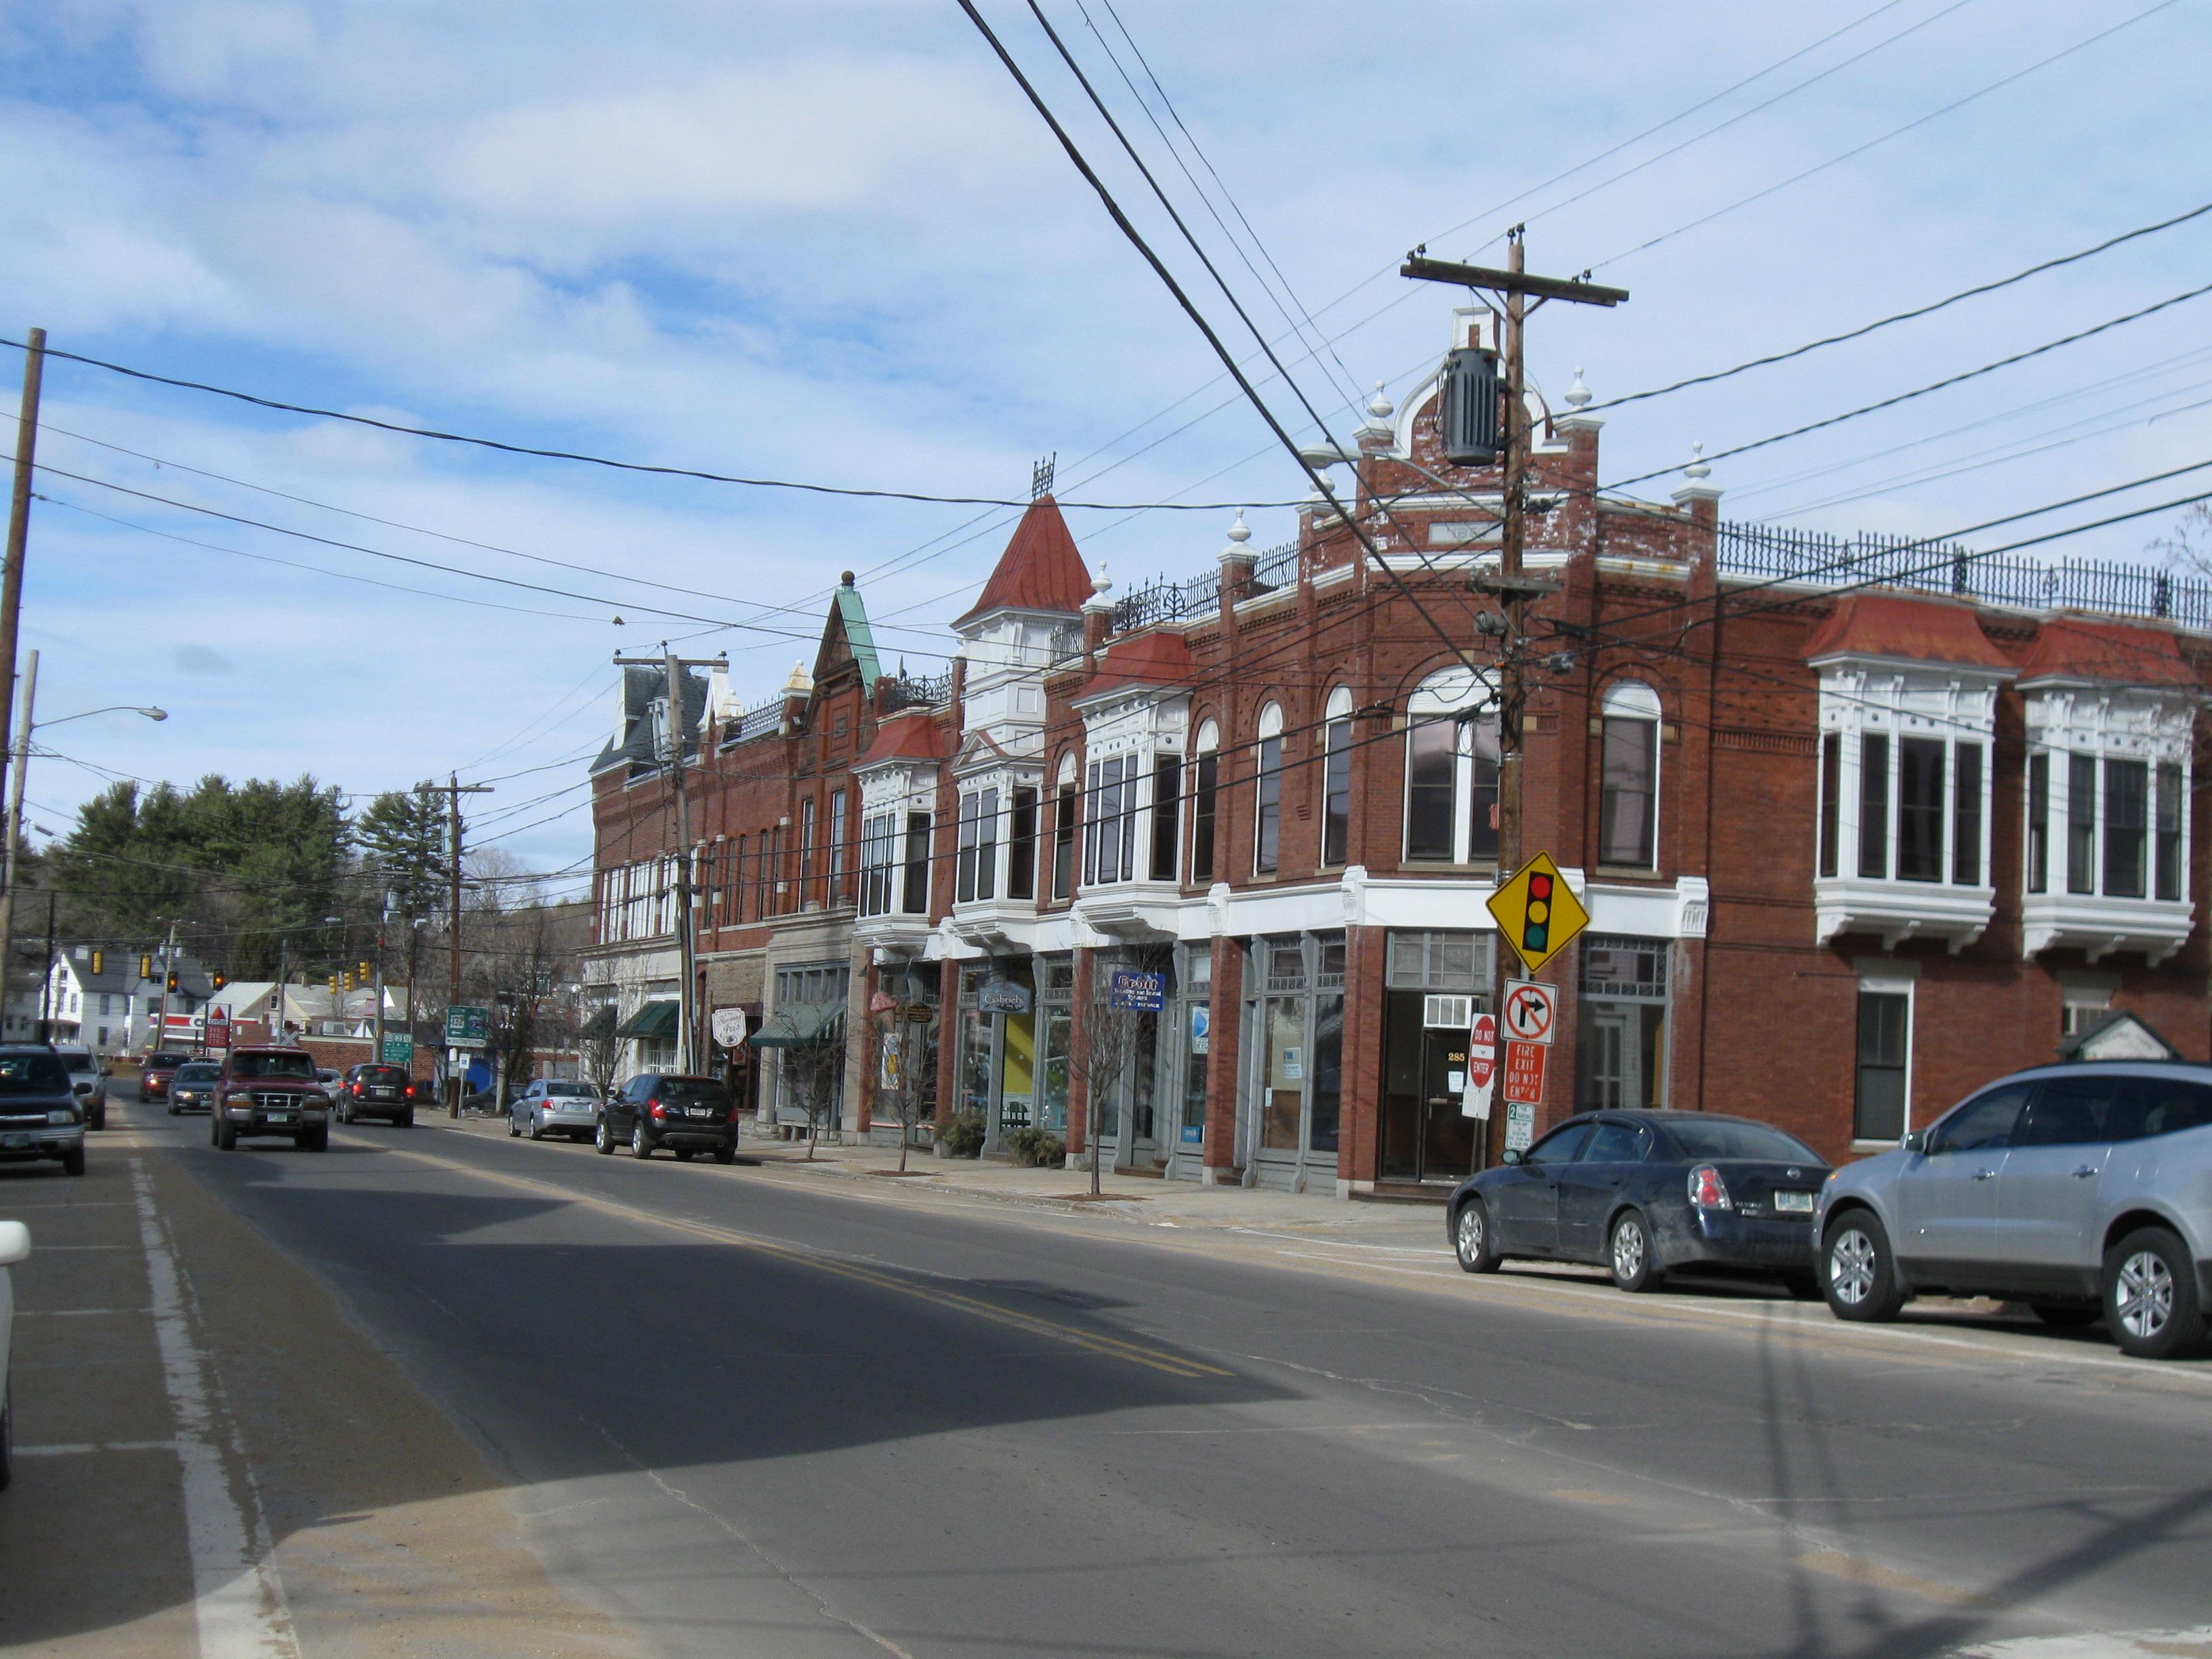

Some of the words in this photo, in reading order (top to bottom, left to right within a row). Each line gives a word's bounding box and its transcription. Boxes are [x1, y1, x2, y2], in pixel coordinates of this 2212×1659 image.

[985, 993, 1024, 1004] Gabriel's
[1475, 1029, 1482, 1040] DO
[1484, 1029, 1494, 1042] NOT
[1448, 1052, 1465, 1062] 285
[1517, 1044, 1535, 1058] FIRE
[1473, 1061, 1490, 1074] ENTER
[1515, 1059, 1534, 1071] EXIT
[1509, 1071, 1519, 1082] DO
[1523, 1073, 1539, 1085] NOT
[1510, 1086, 1535, 1099] ENTR
[1510, 1106, 1516, 1118] 2
